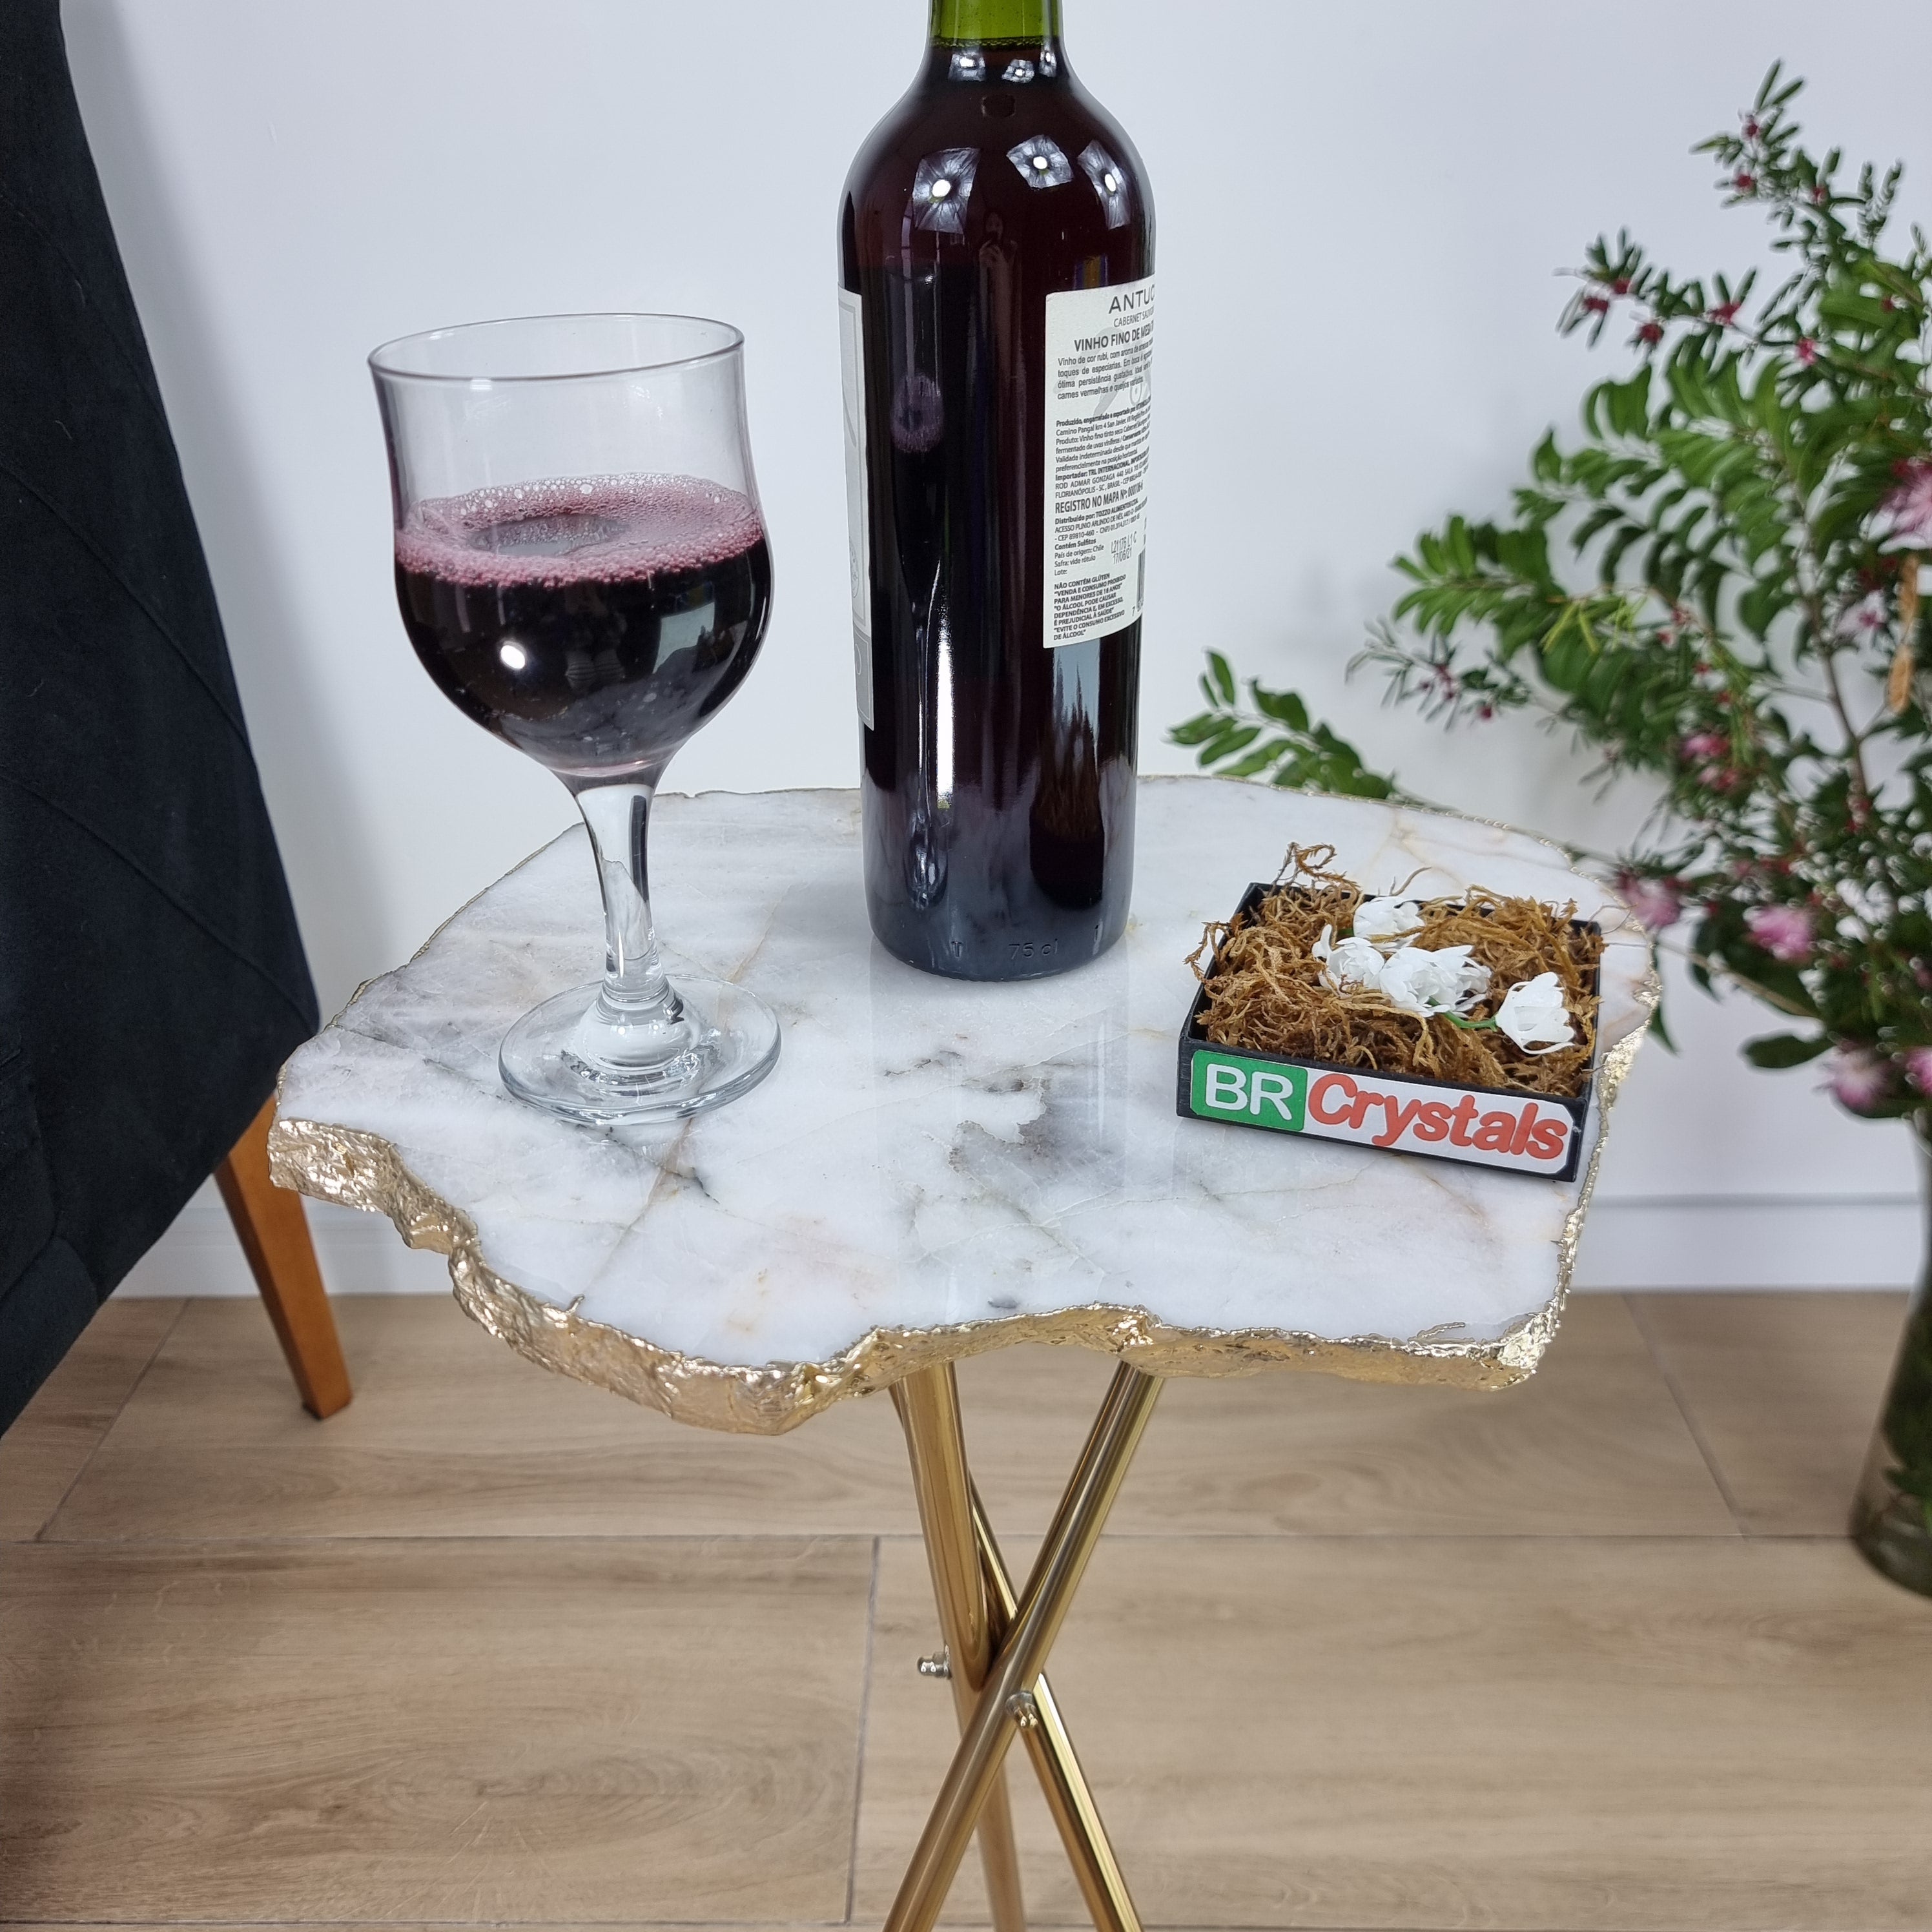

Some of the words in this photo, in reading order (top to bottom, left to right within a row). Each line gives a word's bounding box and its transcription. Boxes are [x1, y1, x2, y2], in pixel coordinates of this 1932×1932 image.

[1114, 312, 1142, 327] CABERNET
[1074, 336, 1108, 351] VINHO
[1111, 333, 1130, 346] FINO
[1132, 329, 1140, 340] DE
[1058, 358, 1076, 366] Vinho
[1098, 353, 1108, 361] rubi,
[1121, 347, 1133, 356] aroma
[1058, 367, 1079, 378] toques
[1092, 362, 1122, 374] especiarias.
[1058, 380, 1074, 388] ótima
[1079, 374, 1111, 387] persistência
[1058, 391, 1078, 400] carnes
[1080, 385, 1108, 396] vermelhas
[1056, 418, 1082, 427] Produzido,
[1084, 413, 1109, 424] engarrafado
[1078, 425, 1094, 436] Pangal
[1080, 433, 1093, 442] Vinho
[1056, 445, 1085, 454] fermentado
[1080, 449, 1112, 460] indeterminada
[1056, 459, 1100, 473] preferencialmente
[1055, 472, 1087, 482] Importador:
[1071, 478, 1090, 488] ADMAR
[1092, 473, 1115, 484] GONZAGA
[1055, 485, 1095, 498] FLORIANÓPOLIS
[1055, 498, 1090, 514] REGISTRO
[1093, 495, 1102, 508] NO
[1104, 491, 1119, 506] MAPA
[1055, 514, 1084, 524] Distribuído
[1085, 513, 1095, 522] por:
[1055, 524, 1074, 533] ACESSO
[1055, 541, 1076, 550] Contém
[1078, 539, 1096, 547] Sulfitos
[1074, 548, 1092, 557] origem:
[1082, 555, 1095, 563] rótulo
[1054, 581, 1067, 589] NÃO
[1069, 577, 1091, 588] CONTÉM
[1092, 573, 1110, 582] GLÚTEN
[1082, 581, 1107, 592] CONSUMO
[1107, 575, 1125, 585] PROIBIDO
[1062, 601, 1084, 610] ÁLCOOL
[1085, 599, 1098, 607] PODE
[1099, 593, 1116, 602] CAUSAR
[1071, 592, 1095, 602] MENORES
[1054, 608, 1092, 619] DEPENDÊNCIA
[1059, 615, 1092, 626] PREJUDICIAL
[1079, 618, 1104, 628] CONSUMO
[1104, 610, 1125, 622] EXCESSIVO
[1009, 942, 1034, 960] 75
[1206, 1062, 1293, 1120] BR
[1308, 1073, 1568, 1160] Crystals
